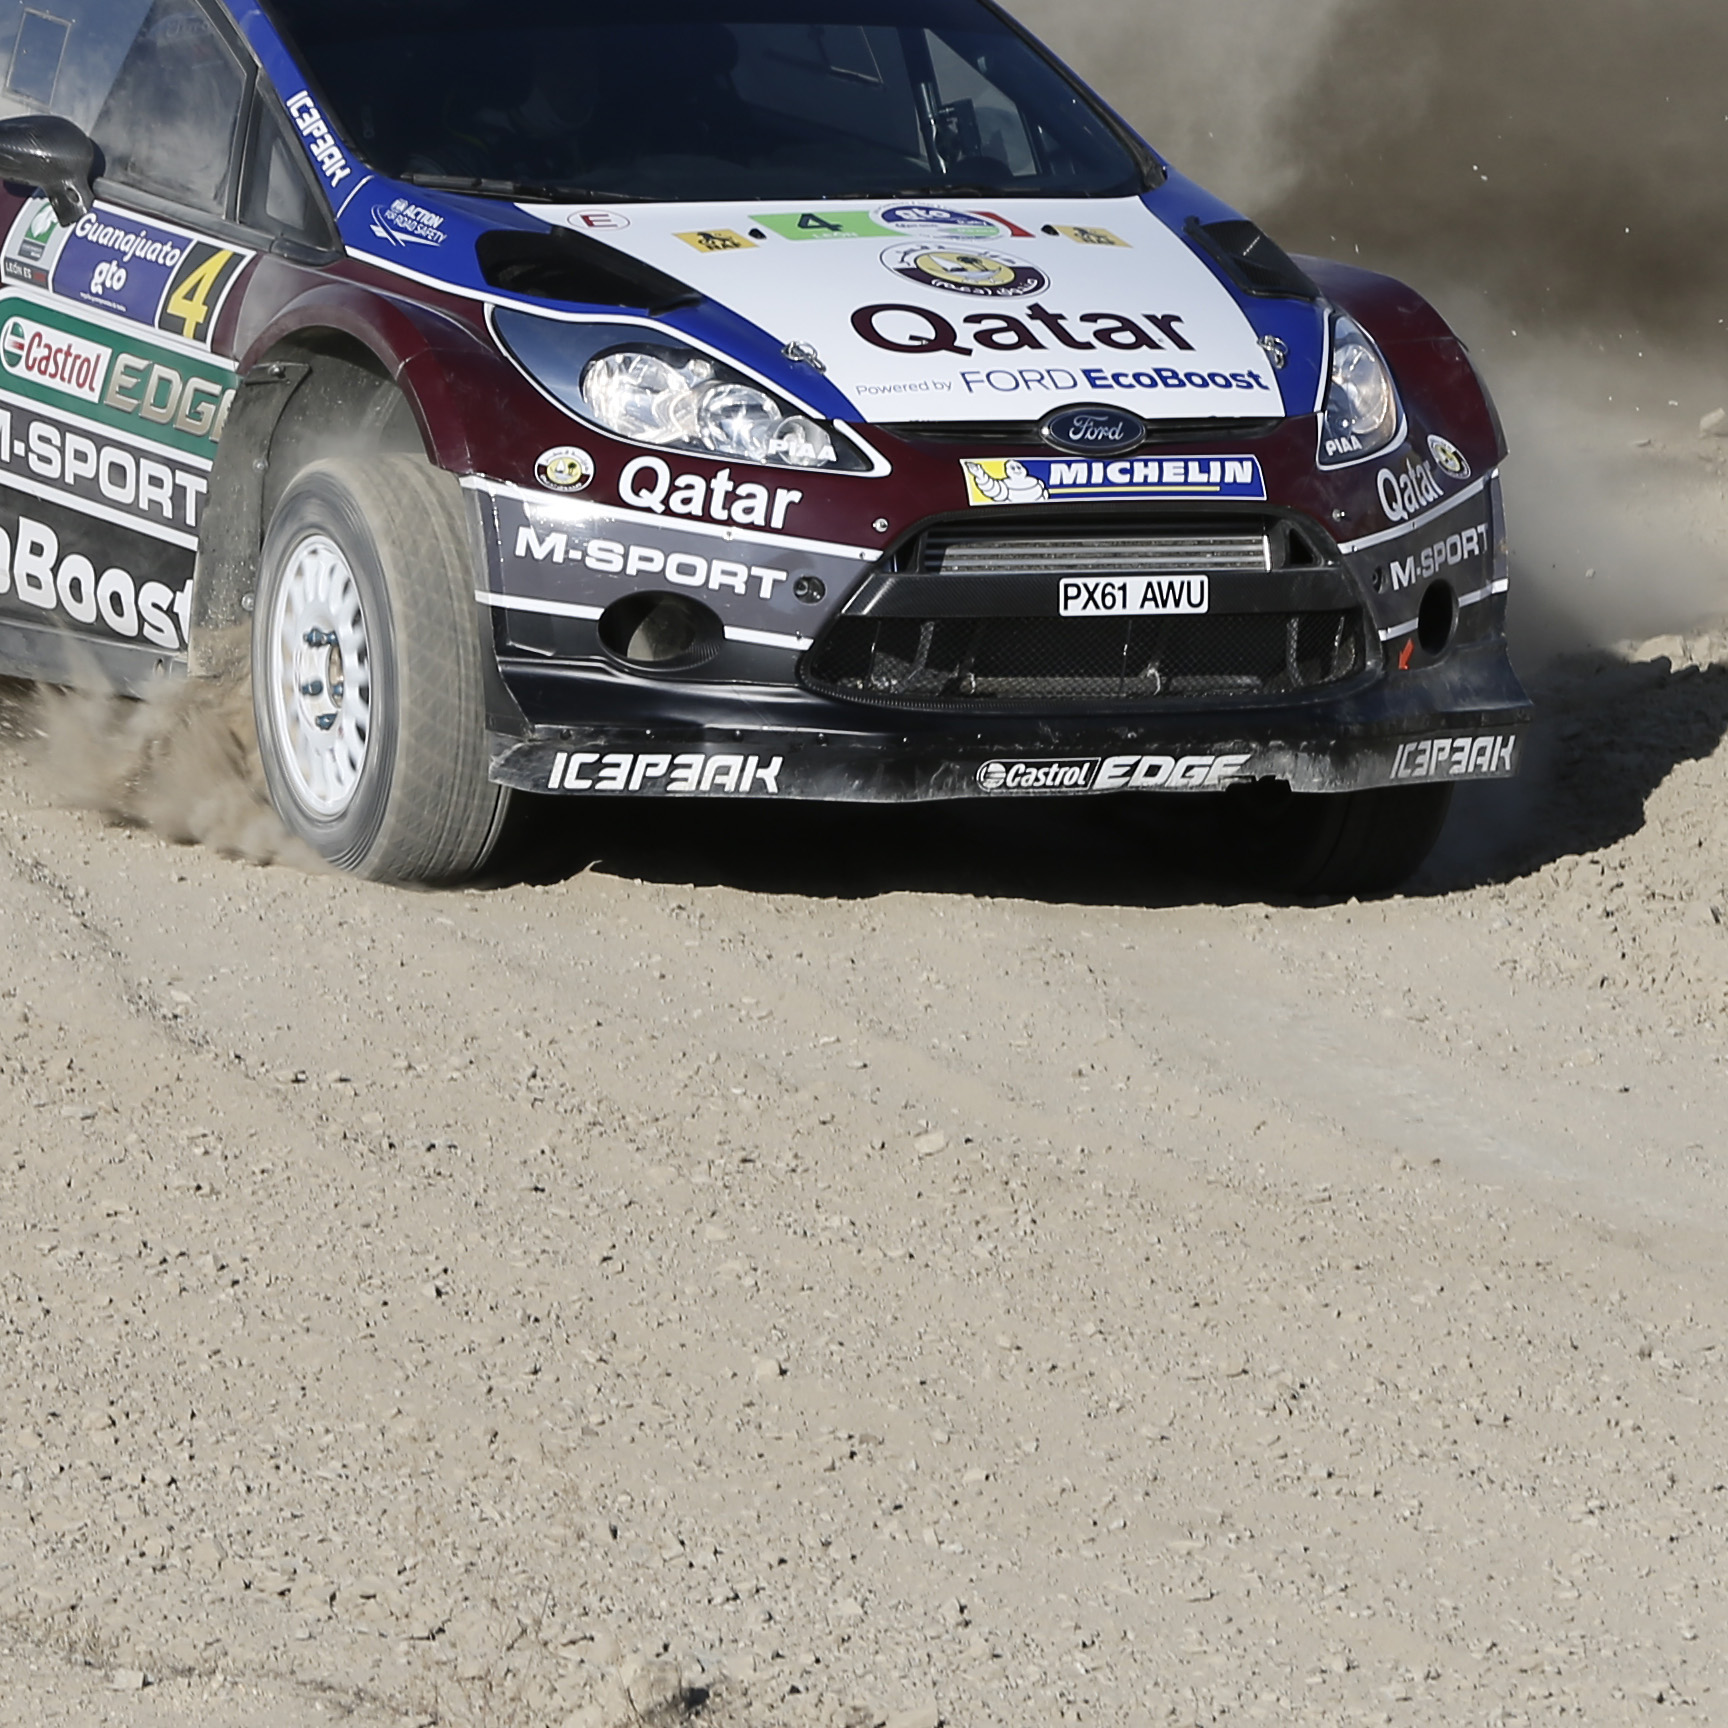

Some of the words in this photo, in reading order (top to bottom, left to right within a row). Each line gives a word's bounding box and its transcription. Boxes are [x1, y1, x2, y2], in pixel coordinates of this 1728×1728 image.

[394, 213, 417, 231] ROAD
[414, 223, 448, 243] SAFETY
[403, 204, 445, 229] ACTION
[797, 213, 844, 232] 4
[75, 212, 181, 267] Guanajuato
[90, 259, 127, 295] gto
[167, 249, 234, 340] 4
[850, 302, 1197, 357] Qatar
[24, 331, 101, 393] Castrol
[855, 379, 928, 396] Powered
[929, 378, 952, 393] by
[960, 369, 1079, 394] FORD
[1083, 367, 1270, 391] EcoBoost
[1068, 414, 1124, 441] Ford
[768, 438, 837, 462] PIAA
[1325, 434, 1363, 456] PIAA
[1048, 460, 1253, 486] MICHELIN
[618, 455, 803, 530] Qatar
[1377, 458, 1444, 521] Qatar
[514, 526, 788, 599] M-SPORT
[1389, 523, 1489, 591] M-SPORT
[1063, 581, 1128, 611] PX61
[1139, 579, 1205, 609] AWU
[1005, 762, 1090, 787] Castrol
